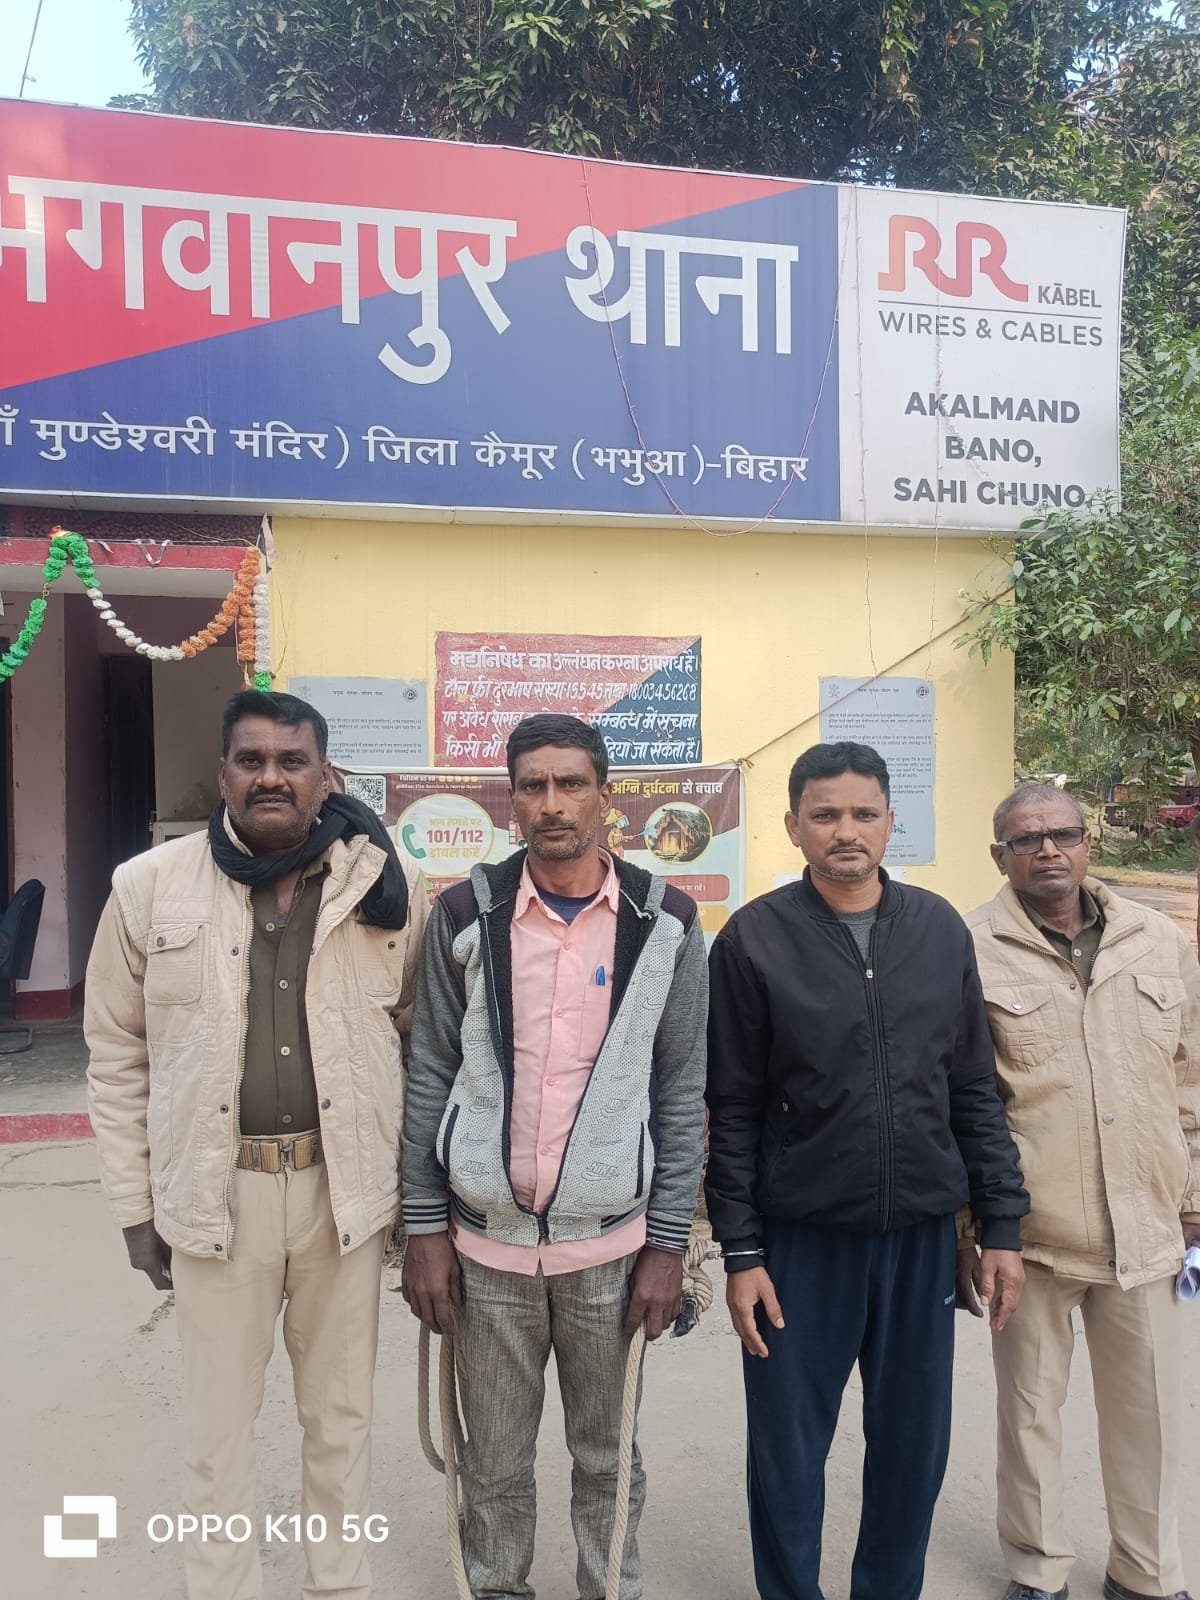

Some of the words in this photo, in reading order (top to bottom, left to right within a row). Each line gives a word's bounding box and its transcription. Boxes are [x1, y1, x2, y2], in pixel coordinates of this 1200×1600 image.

[878, 214, 1029, 303] RR
[564, 225, 799, 354] थाना
[878, 310, 966, 338] WIRES
[976, 318, 992, 340] &
[1002, 320, 1103, 347] CABLES
[904, 391, 1081, 424] AKALMAND
[30, 411, 216, 461] मुण्डेश्वरी
[361, 425, 459, 466] जिला
[470, 431, 558, 480] कैमूर
[945, 435, 1042, 468] BANO,
[893, 477, 967, 504] SAHI
[426, 827, 484, 846] 101/112
